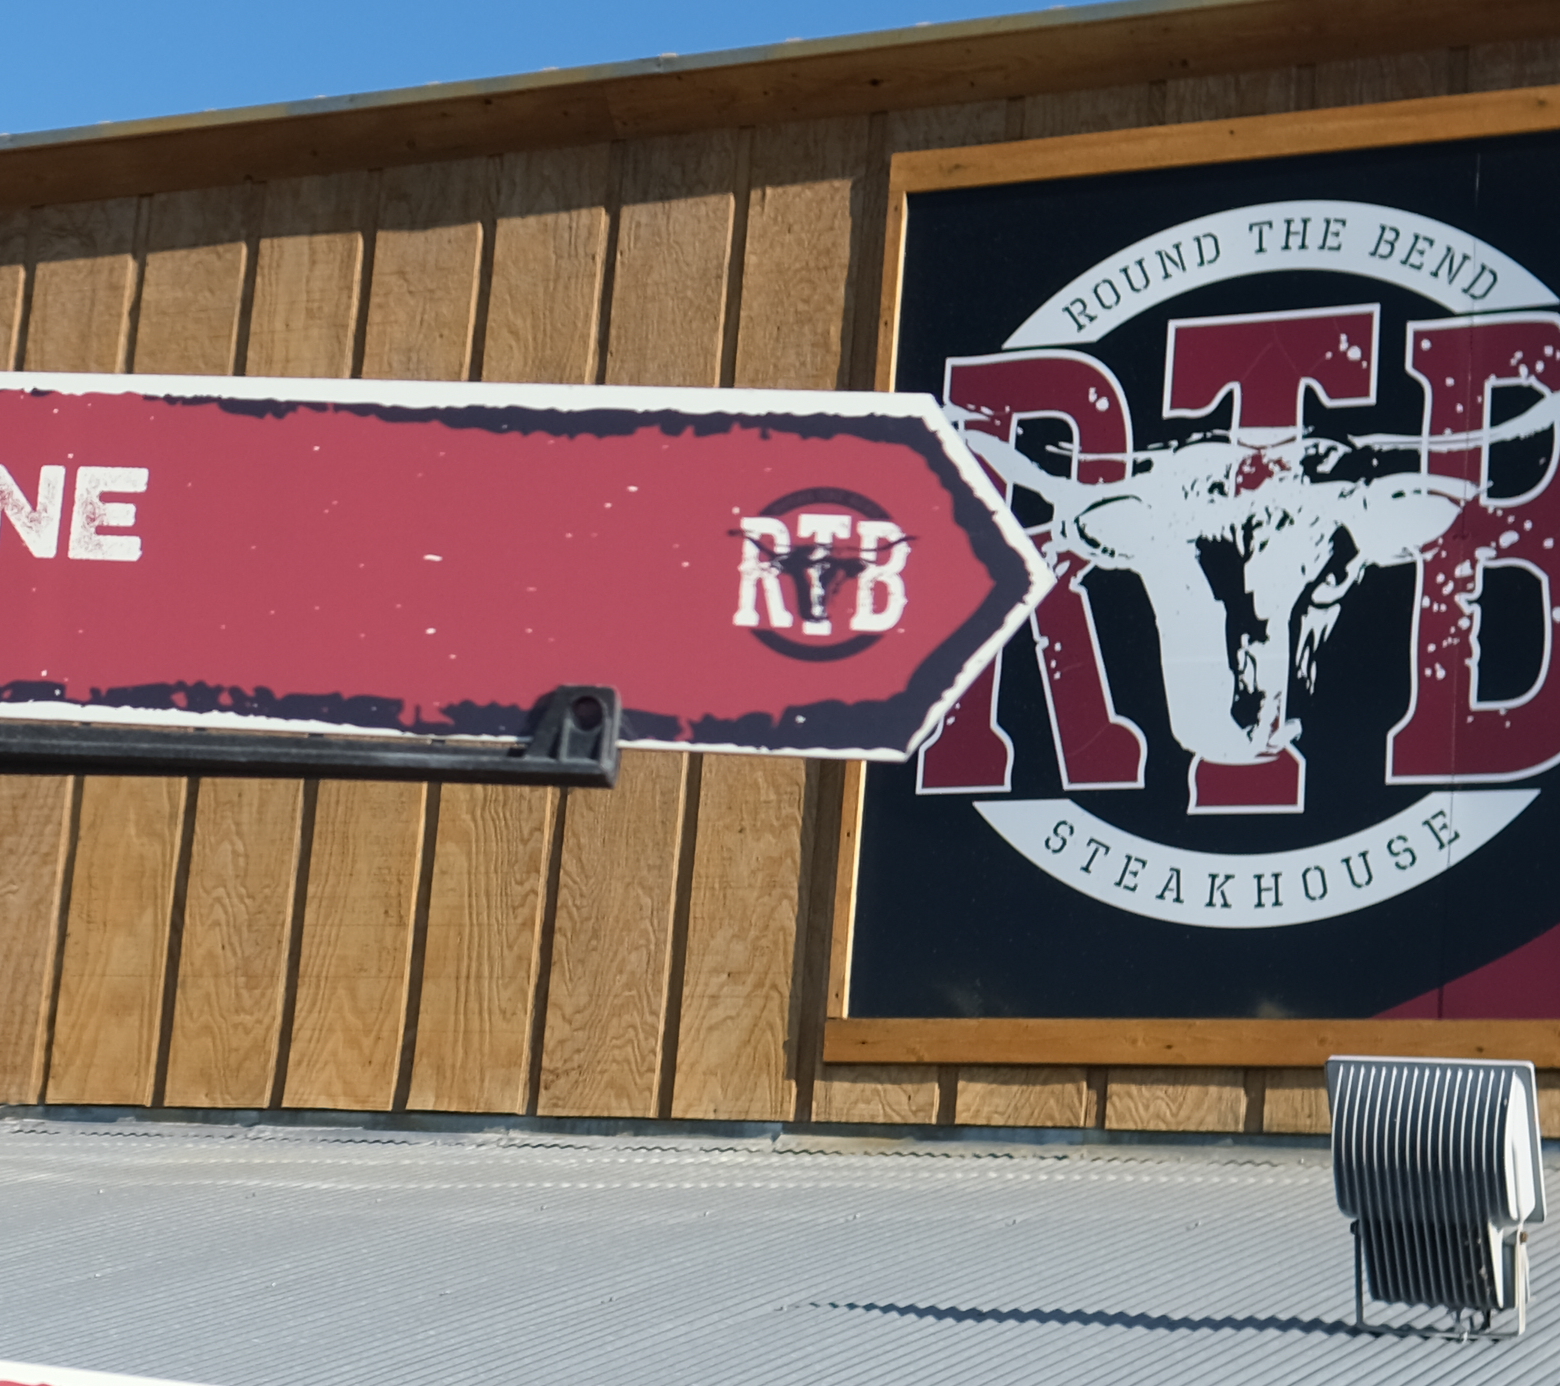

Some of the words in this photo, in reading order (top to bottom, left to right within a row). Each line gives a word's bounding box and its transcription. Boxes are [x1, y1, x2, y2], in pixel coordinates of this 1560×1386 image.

[1062, 230, 1223, 334] ROUND
[1248, 216, 1346, 256] THE
[1369, 223, 1501, 303] BEND
[733, 514, 911, 635] RTB
[1044, 810, 1461, 910] STEAKHOUSE
